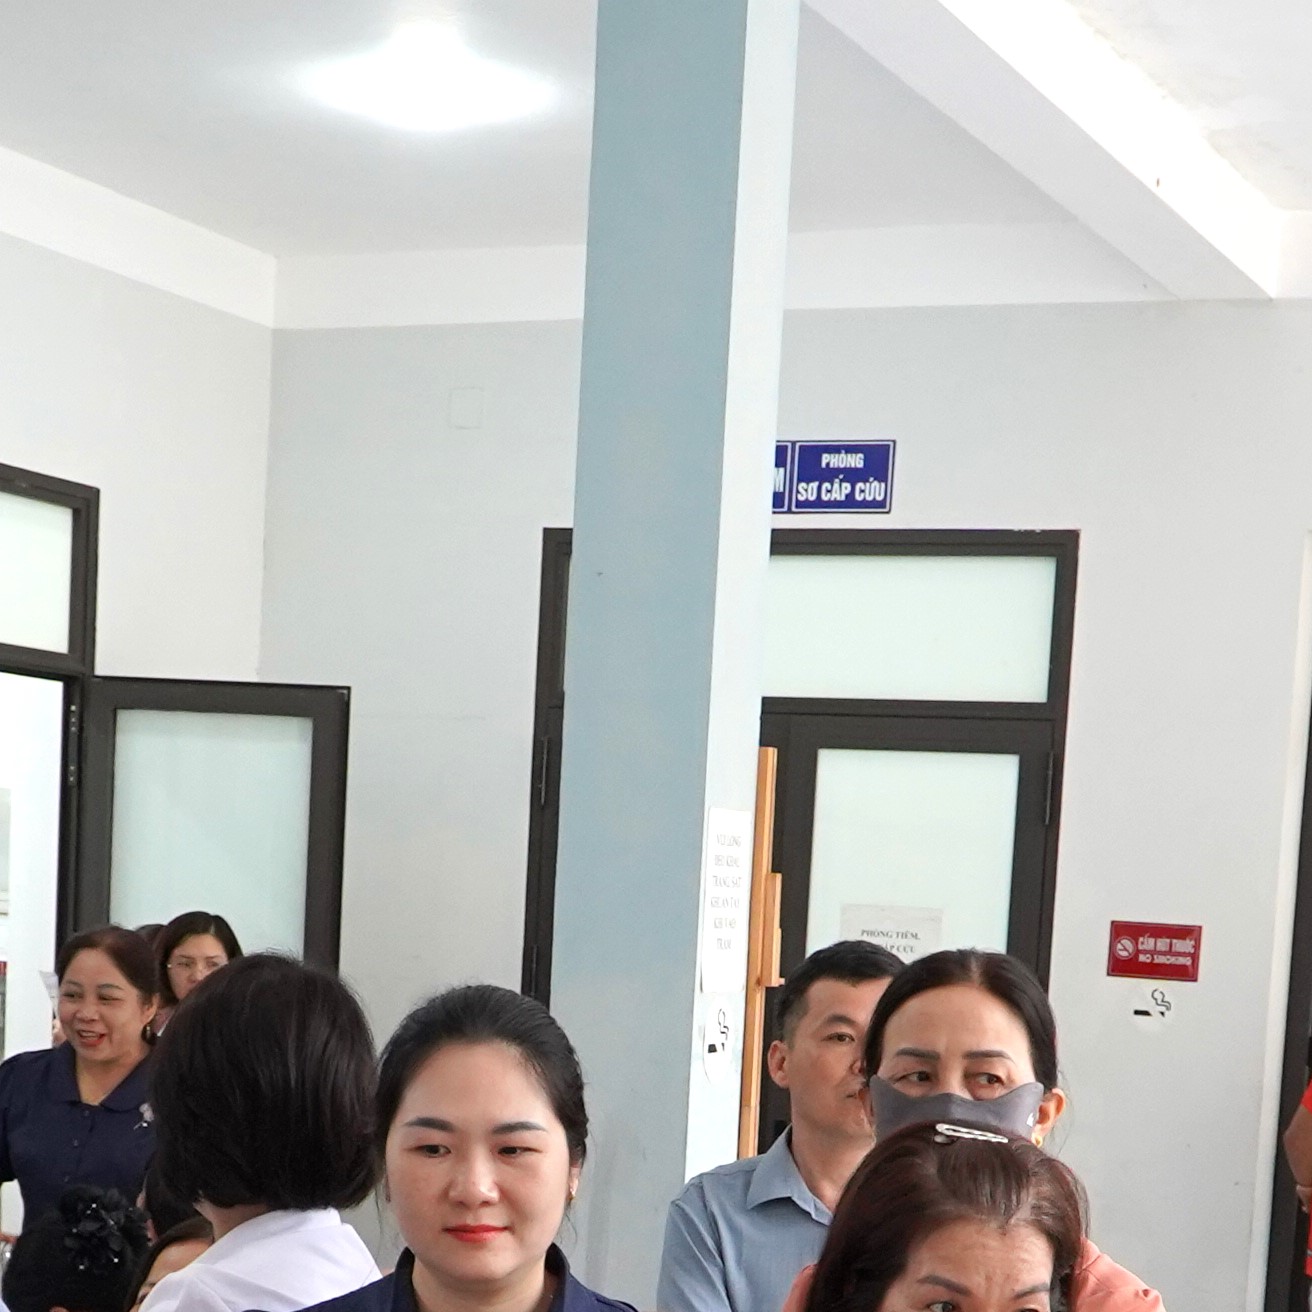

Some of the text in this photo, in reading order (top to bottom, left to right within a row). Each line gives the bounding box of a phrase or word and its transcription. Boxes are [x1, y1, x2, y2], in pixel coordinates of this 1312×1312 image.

[821, 450, 865, 468] PHÒNG
[797, 474, 886, 501] SƠ CẤP CỨU
